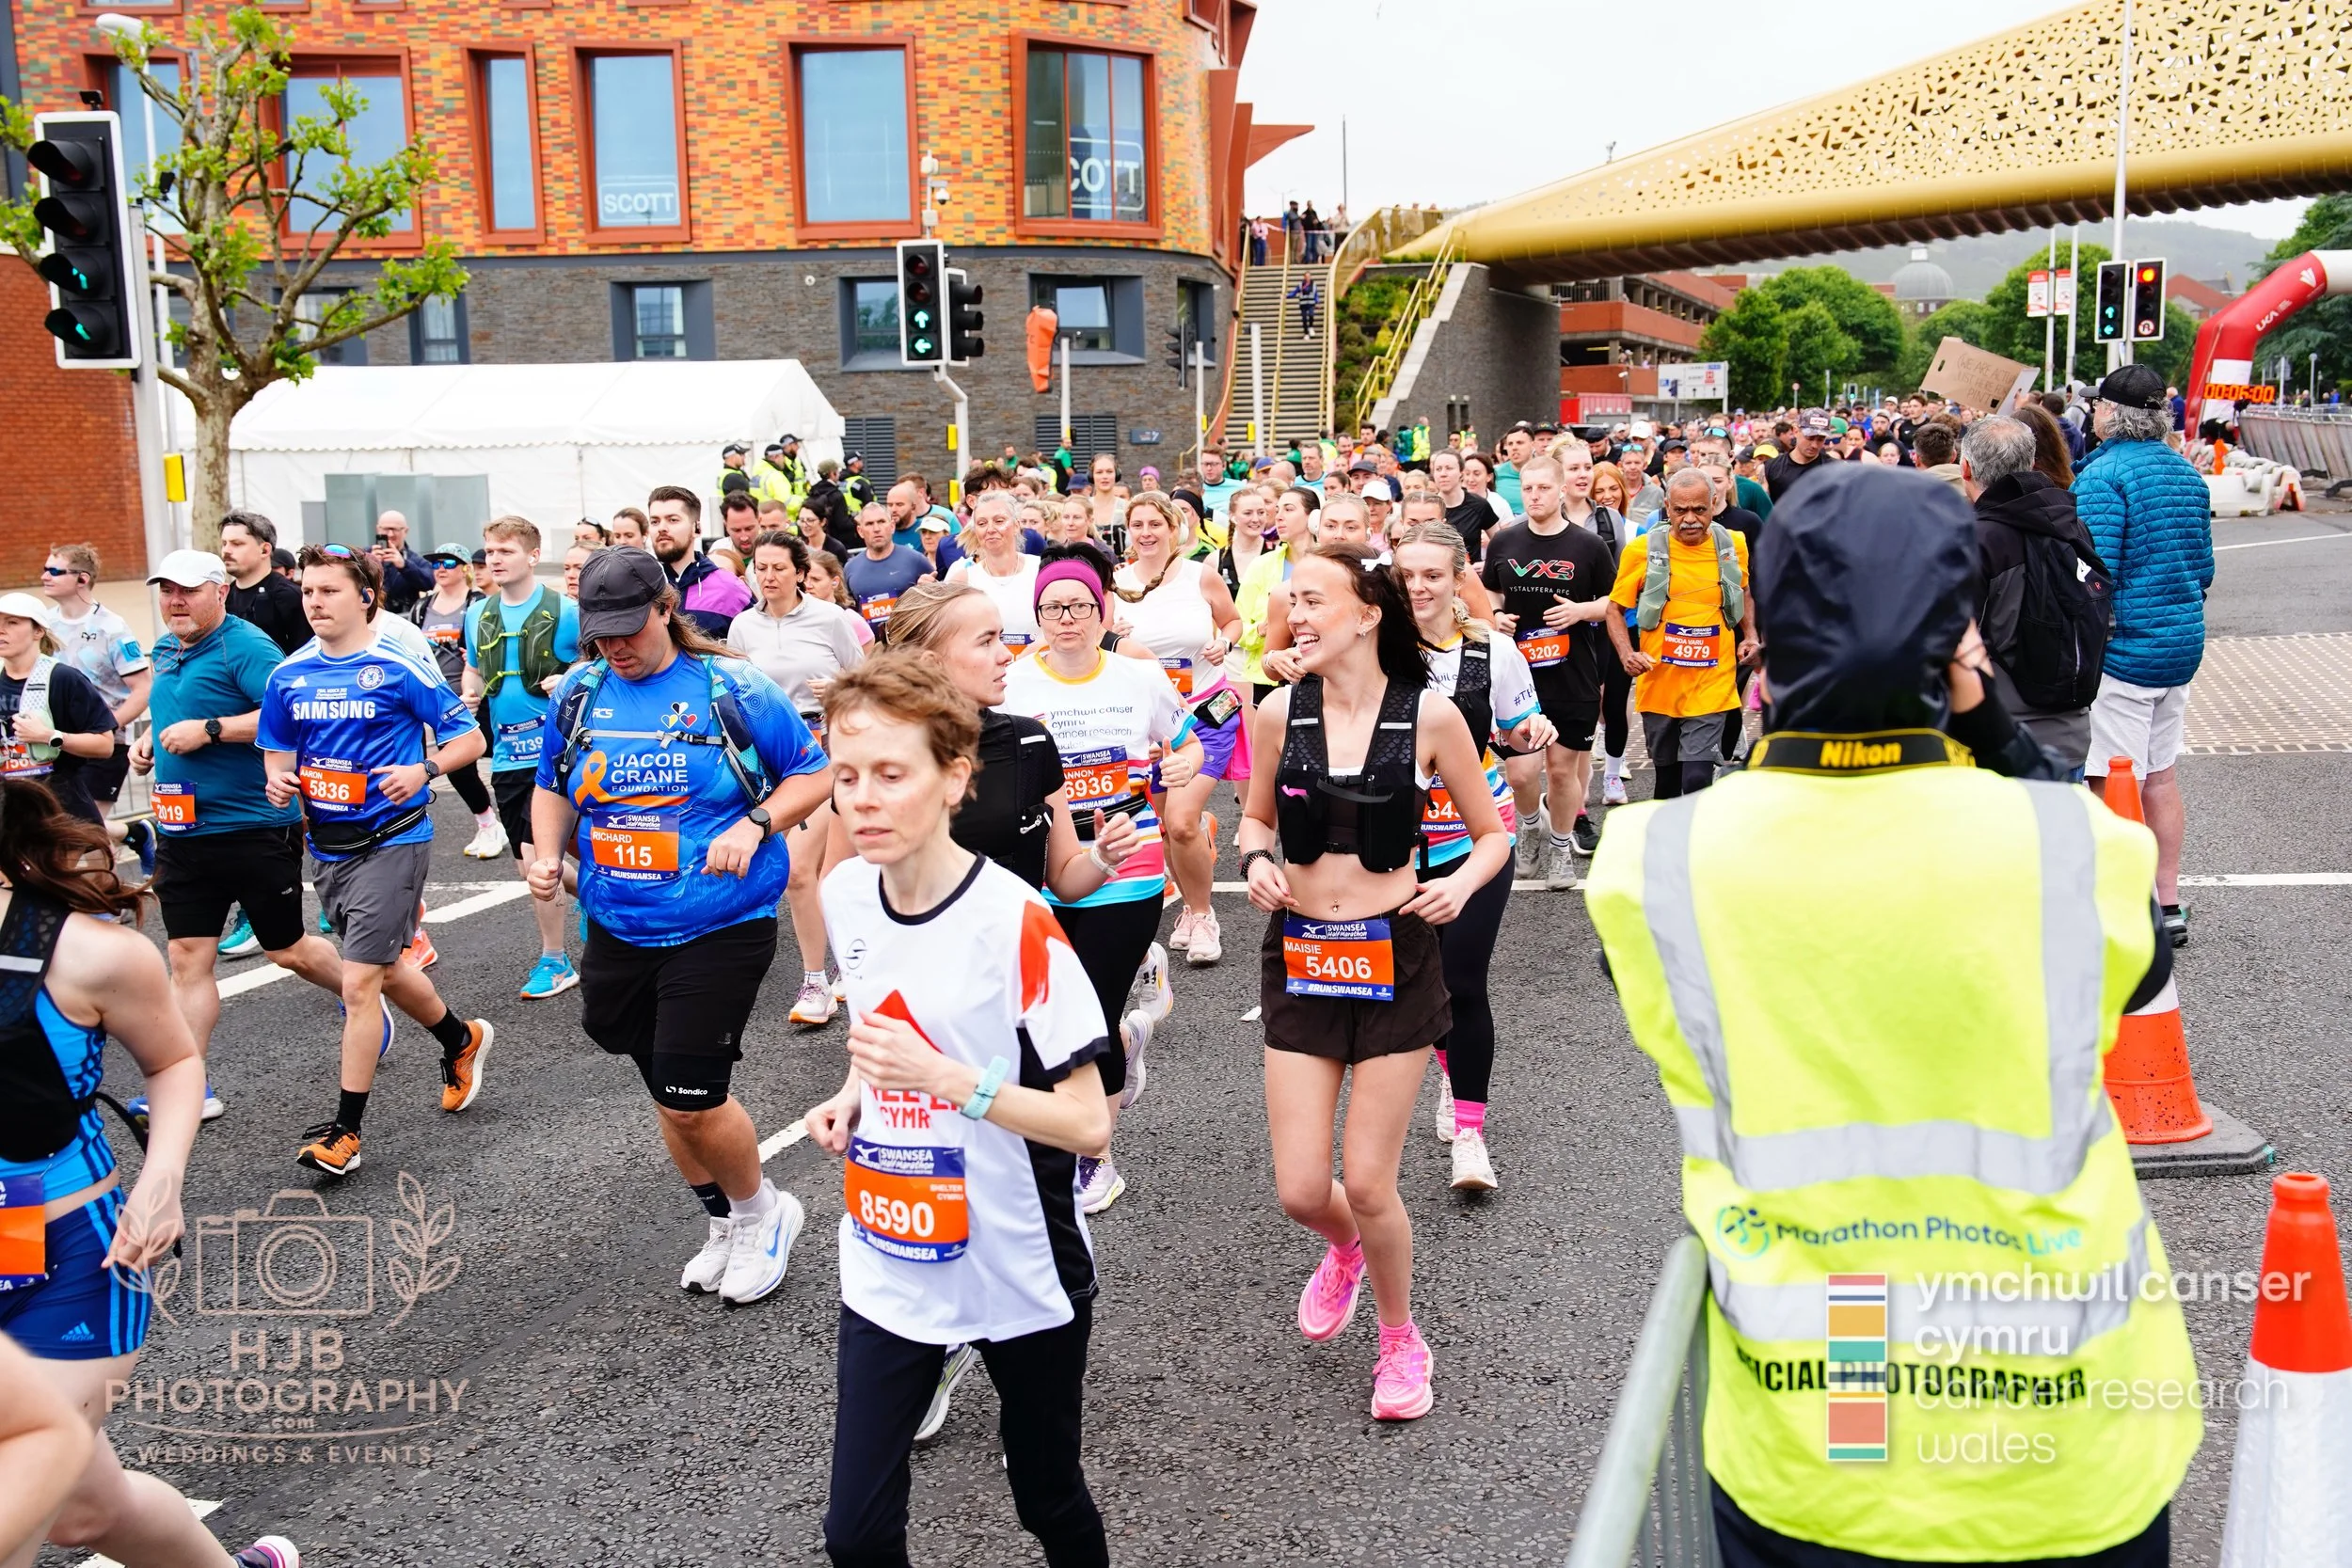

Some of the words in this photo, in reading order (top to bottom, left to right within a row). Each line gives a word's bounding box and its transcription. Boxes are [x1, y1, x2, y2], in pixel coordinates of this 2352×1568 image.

[603, 192, 675, 214] SCOTT
[2203, 383, 2275, 404] 00:06:00
[1507, 559, 1576, 581] VX3
[1509, 586, 1553, 594] YSTALYFERA
[1556, 588, 1570, 596] RFC
[1528, 644, 1562, 660] 3202
[1673, 644, 1710, 659] 4979
[293, 700, 375, 721] SAMSUNG
[592, 707, 613, 719] RCS
[1050, 708, 1097, 720] ymchwil
[1099, 705, 1133, 715] canser
[1052, 720, 1086, 730] cymru
[1053, 729, 1087, 739] cancer
[1089, 727, 1133, 736] research
[511, 736, 544, 752] 2739
[612, 752, 687, 768] JACOB
[1082, 750, 1112, 760] SWANSEA
[1819, 740, 1902, 768] Nikon
[301, 769, 324, 780] AARON
[611, 769, 689, 784] CRANE
[310, 780, 350, 800] 5836
[612, 784, 689, 793] FOUNDATION
[1065, 774, 1114, 800] 6936
[157, 804, 183, 821] 2019
[592, 831, 632, 843] RICHARD
[614, 844, 653, 866] 115
[610, 869, 662, 880] #RUNSWANSEA
[1327, 923, 1367, 932] SWANSEA
[1284, 941, 1322, 955] MAISIE
[1305, 955, 1373, 979] 5406
[1307, 983, 1373, 997] #RUNSWANSEA
[677, 1086, 708, 1096] Sondico
[881, 1147, 934, 1162] SWANSEA
[930, 1183, 963, 1193] SHELTER
[936, 1193, 964, 1201] CYMRU
[859, 1189, 934, 1238] 8590
[1775, 1218, 1919, 1246] Marathon
[1926, 1216, 2023, 1251] Photos
[2026, 1227, 2083, 1257] Live
[1840, 1357, 2086, 1405] PHOTOGRAPHER
